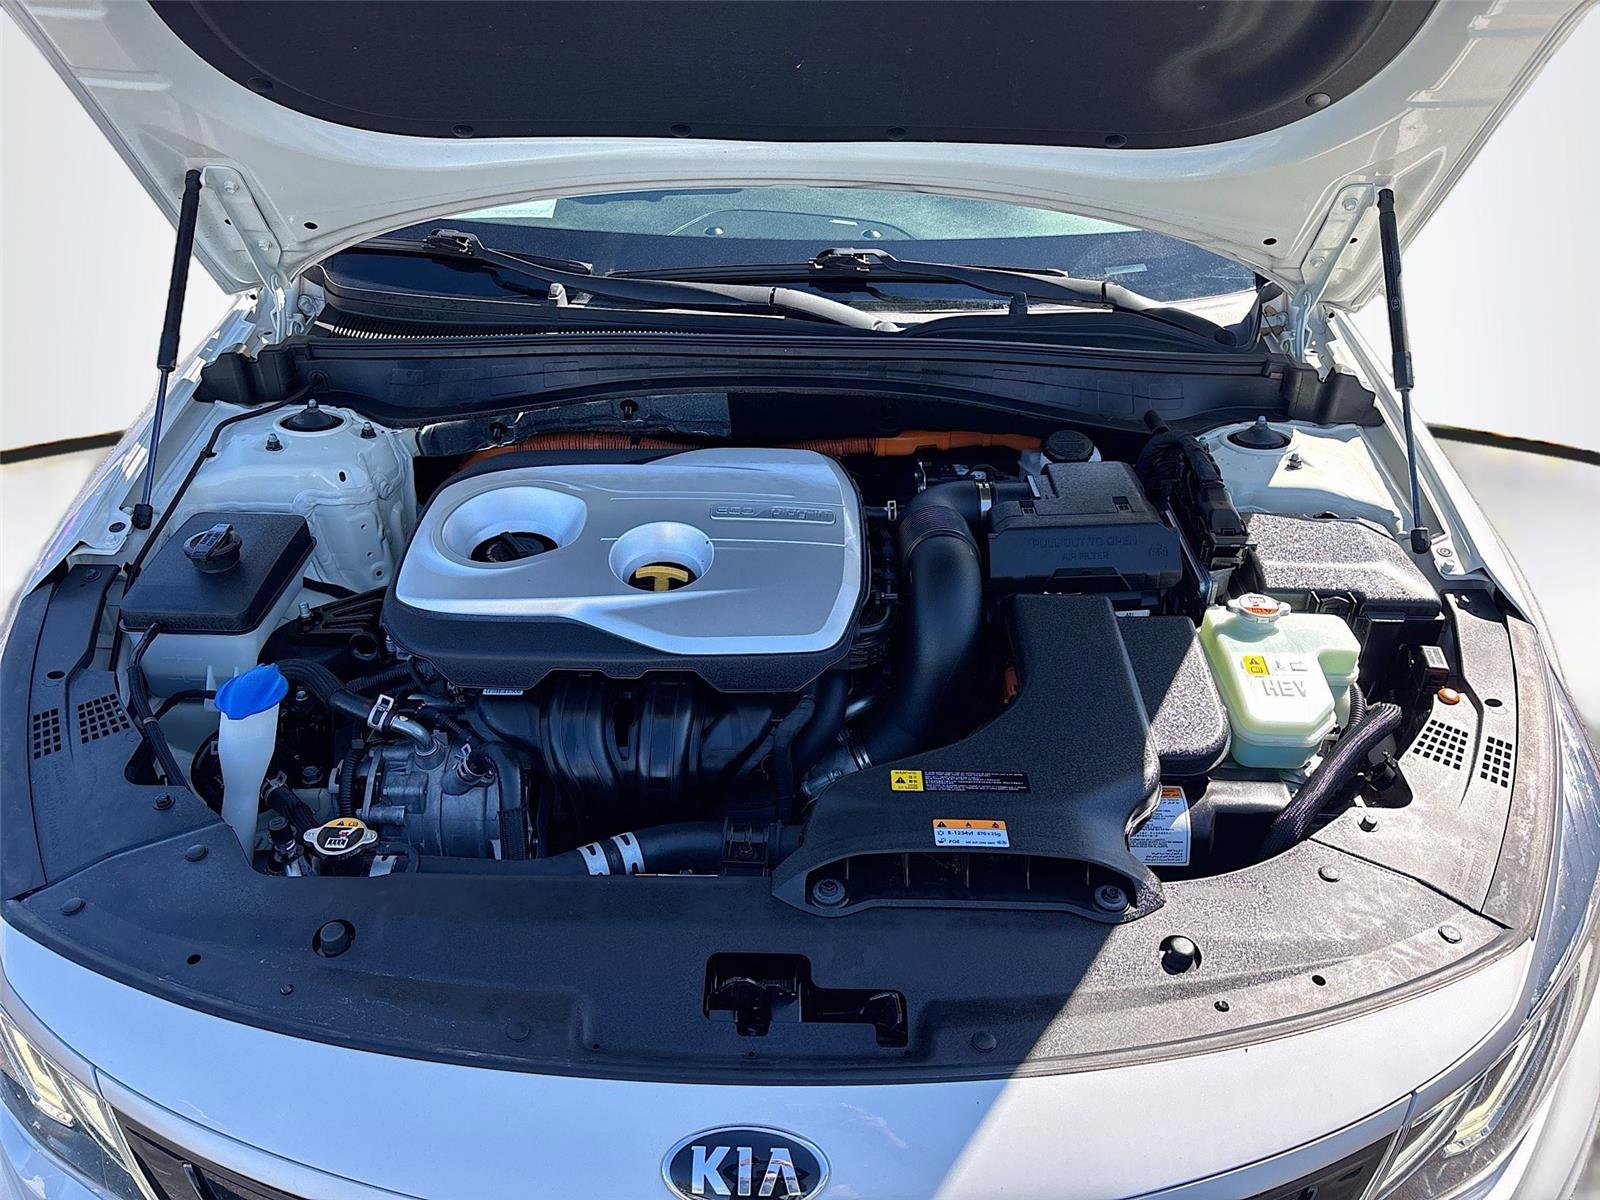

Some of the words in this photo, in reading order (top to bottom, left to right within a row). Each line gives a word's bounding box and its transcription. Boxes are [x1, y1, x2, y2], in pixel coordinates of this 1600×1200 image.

[1032, 538, 1060, 549] PULL
[1107, 535, 1138, 547] OPEN
[1079, 551, 1110, 561] FILTER
[1262, 680, 1307, 698] HEV
[691, 1146, 801, 1197] KIA
